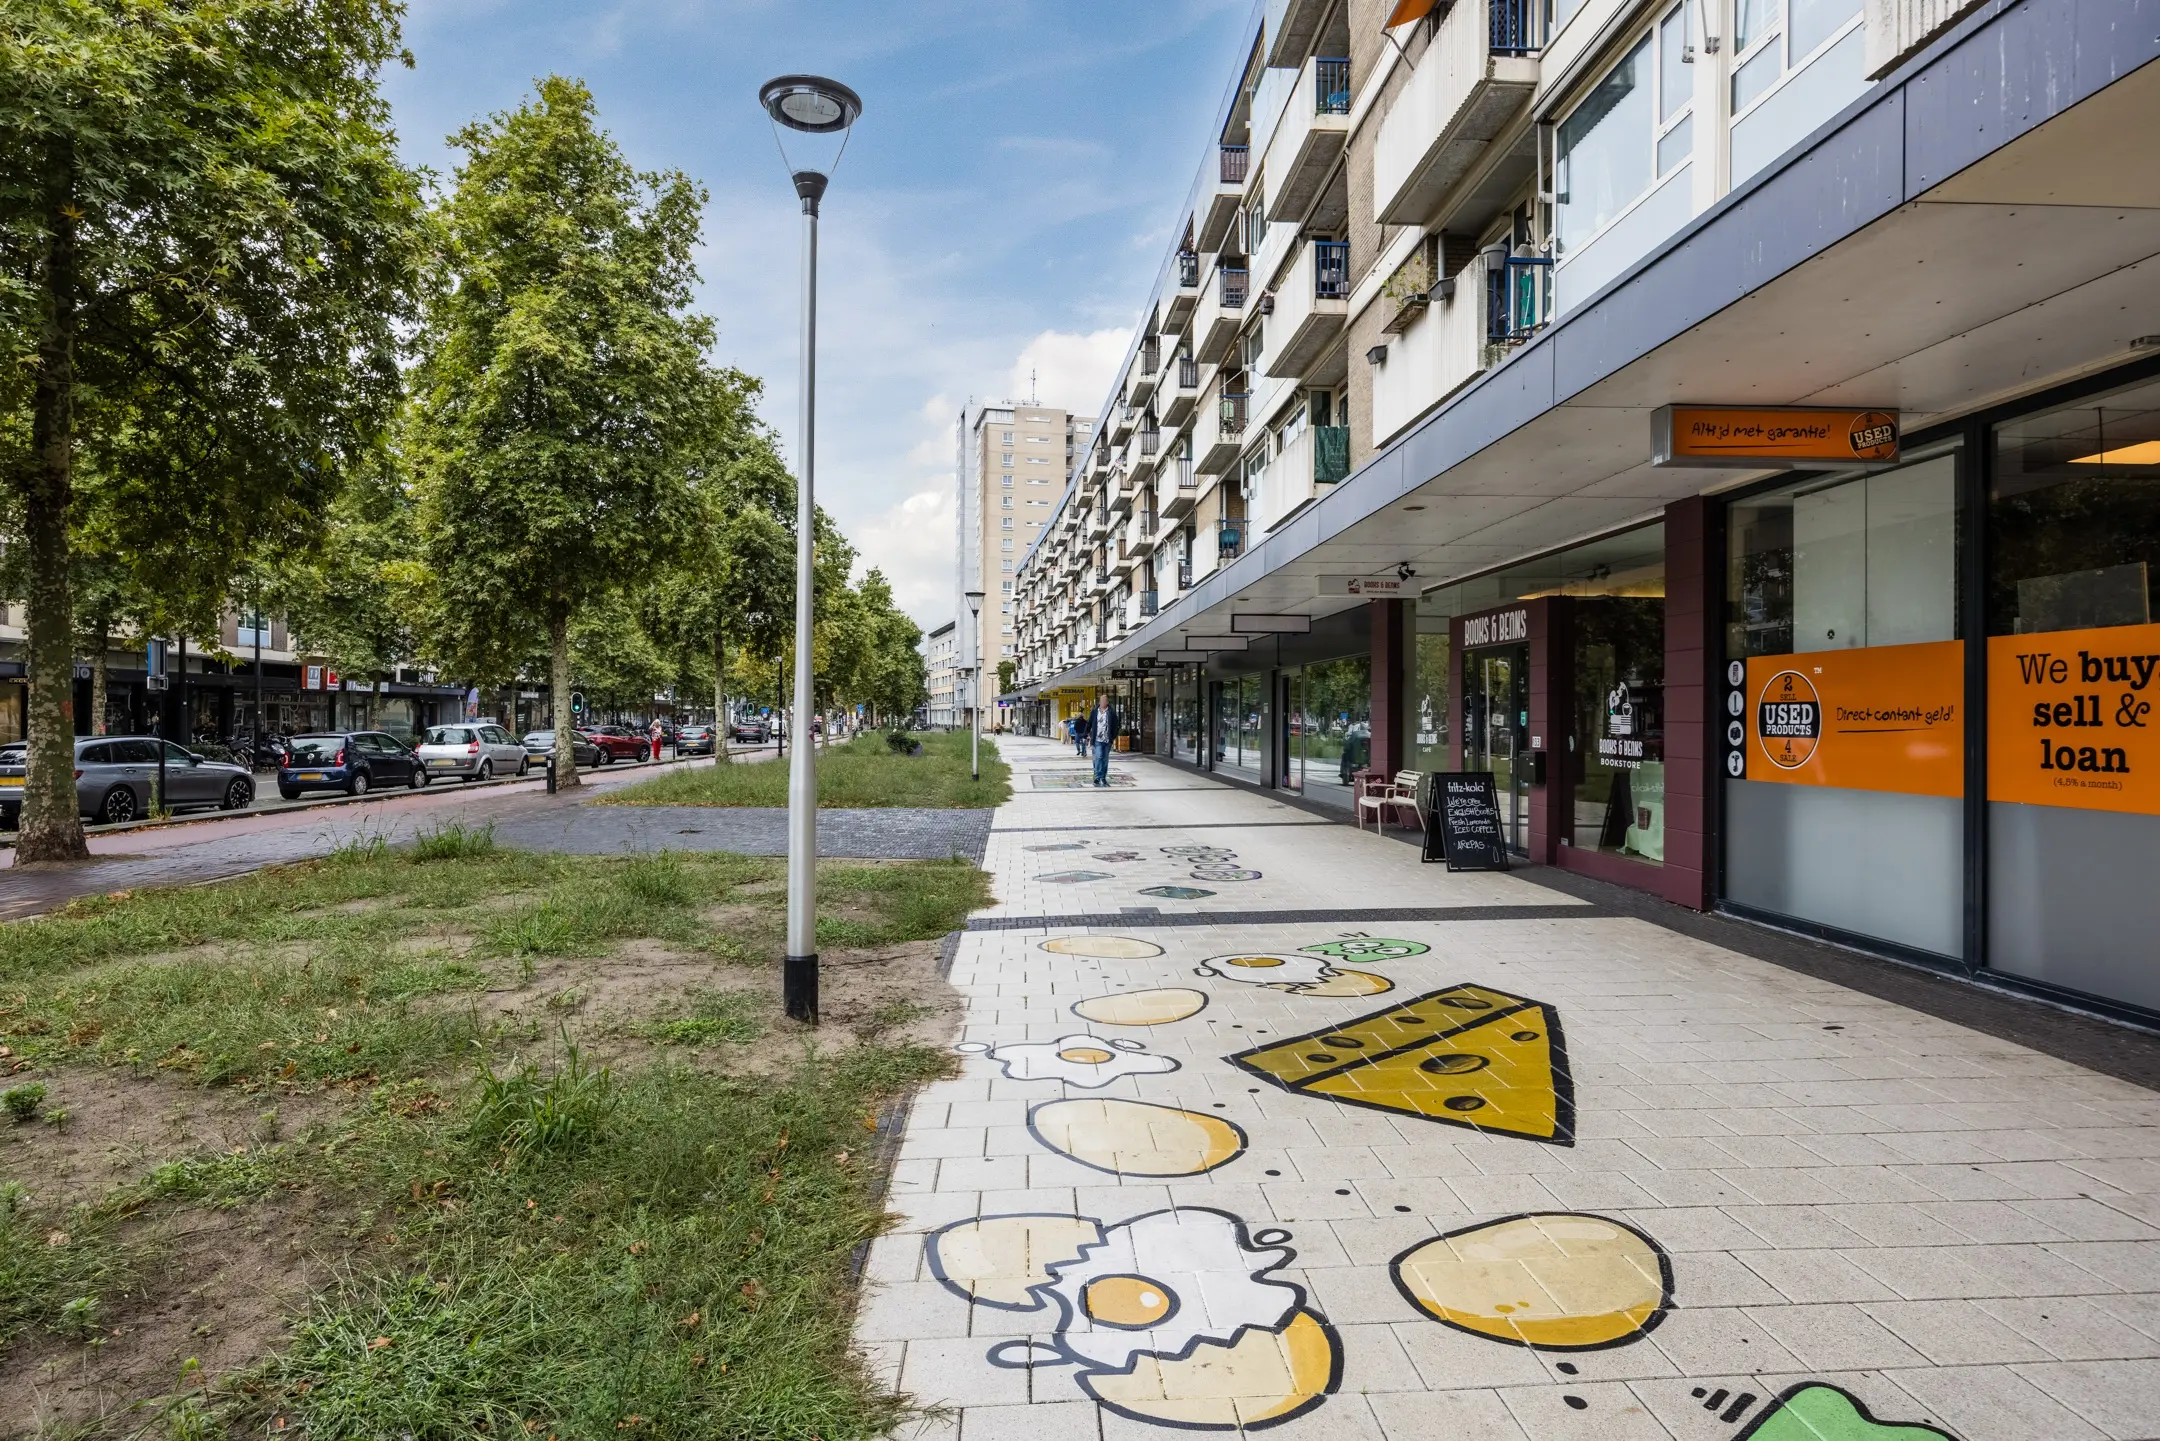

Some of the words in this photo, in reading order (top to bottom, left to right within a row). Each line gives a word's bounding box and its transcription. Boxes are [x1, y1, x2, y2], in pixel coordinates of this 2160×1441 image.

[1692, 422, 1730, 440] Altijd
[1734, 424, 1764, 436] met
[1768, 424, 1830, 441] garantie!
[1854, 426, 1892, 443] USED
[1858, 436, 1892, 448] PRODUCTS
[1465, 616, 1489, 646] BOOKS
[1491, 615, 1497, 642] &
[1499, 609, 1526, 641] BEANS
[2016, 653, 2068, 684] We
[2078, 651, 2160, 690] buy
[1784, 675, 1793, 691] 2
[1765, 704, 1813, 724] USED
[1836, 707, 1872, 721] Direct
[1874, 706, 1922, 721] contant
[1925, 705, 1954, 725] geld!
[2033, 695, 2103, 727] sell
[2115, 693, 2150, 727] &
[1766, 725, 1812, 735] PRODUCTS
[1599, 739, 1617, 754] BOOKS
[1618, 740, 1623, 755] &
[1624, 740, 1642, 757] BEANS
[1785, 740, 1791, 753] 4
[1601, 758, 1640, 769] BOOKSTORE
[2040, 738, 2130, 773] loan
[1448, 782, 1485, 792] fritz-kola
[2054, 777, 2078, 787] (4,5%
[2088, 781, 2123, 791] month)
[1457, 840, 1485, 850] AREPAS
